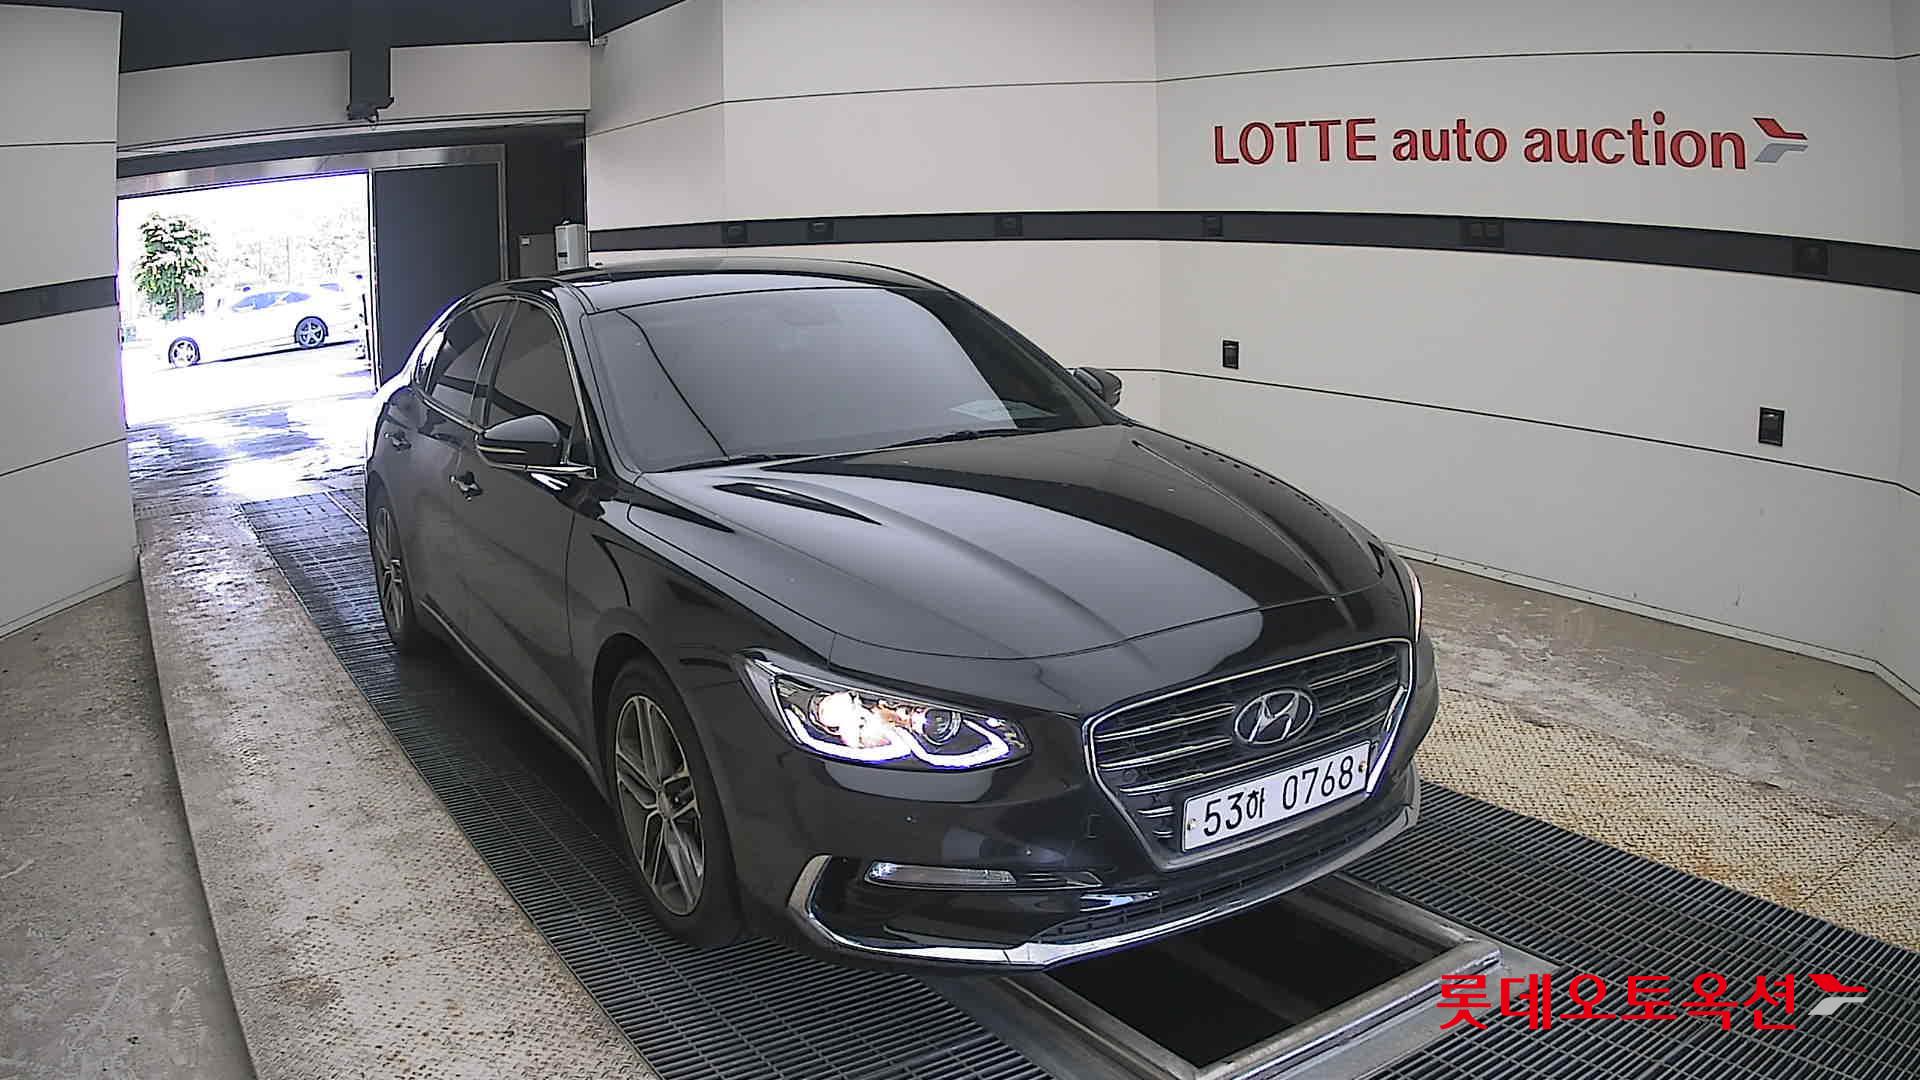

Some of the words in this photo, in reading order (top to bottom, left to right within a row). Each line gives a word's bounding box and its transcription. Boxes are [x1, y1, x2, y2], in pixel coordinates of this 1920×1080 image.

[1213, 118, 1376, 164] LOTTE
[1392, 117, 1508, 163] auto
[1523, 110, 1747, 170] auction
[1203, 787, 1265, 837] 53하
[1282, 755, 1354, 810] 0768
